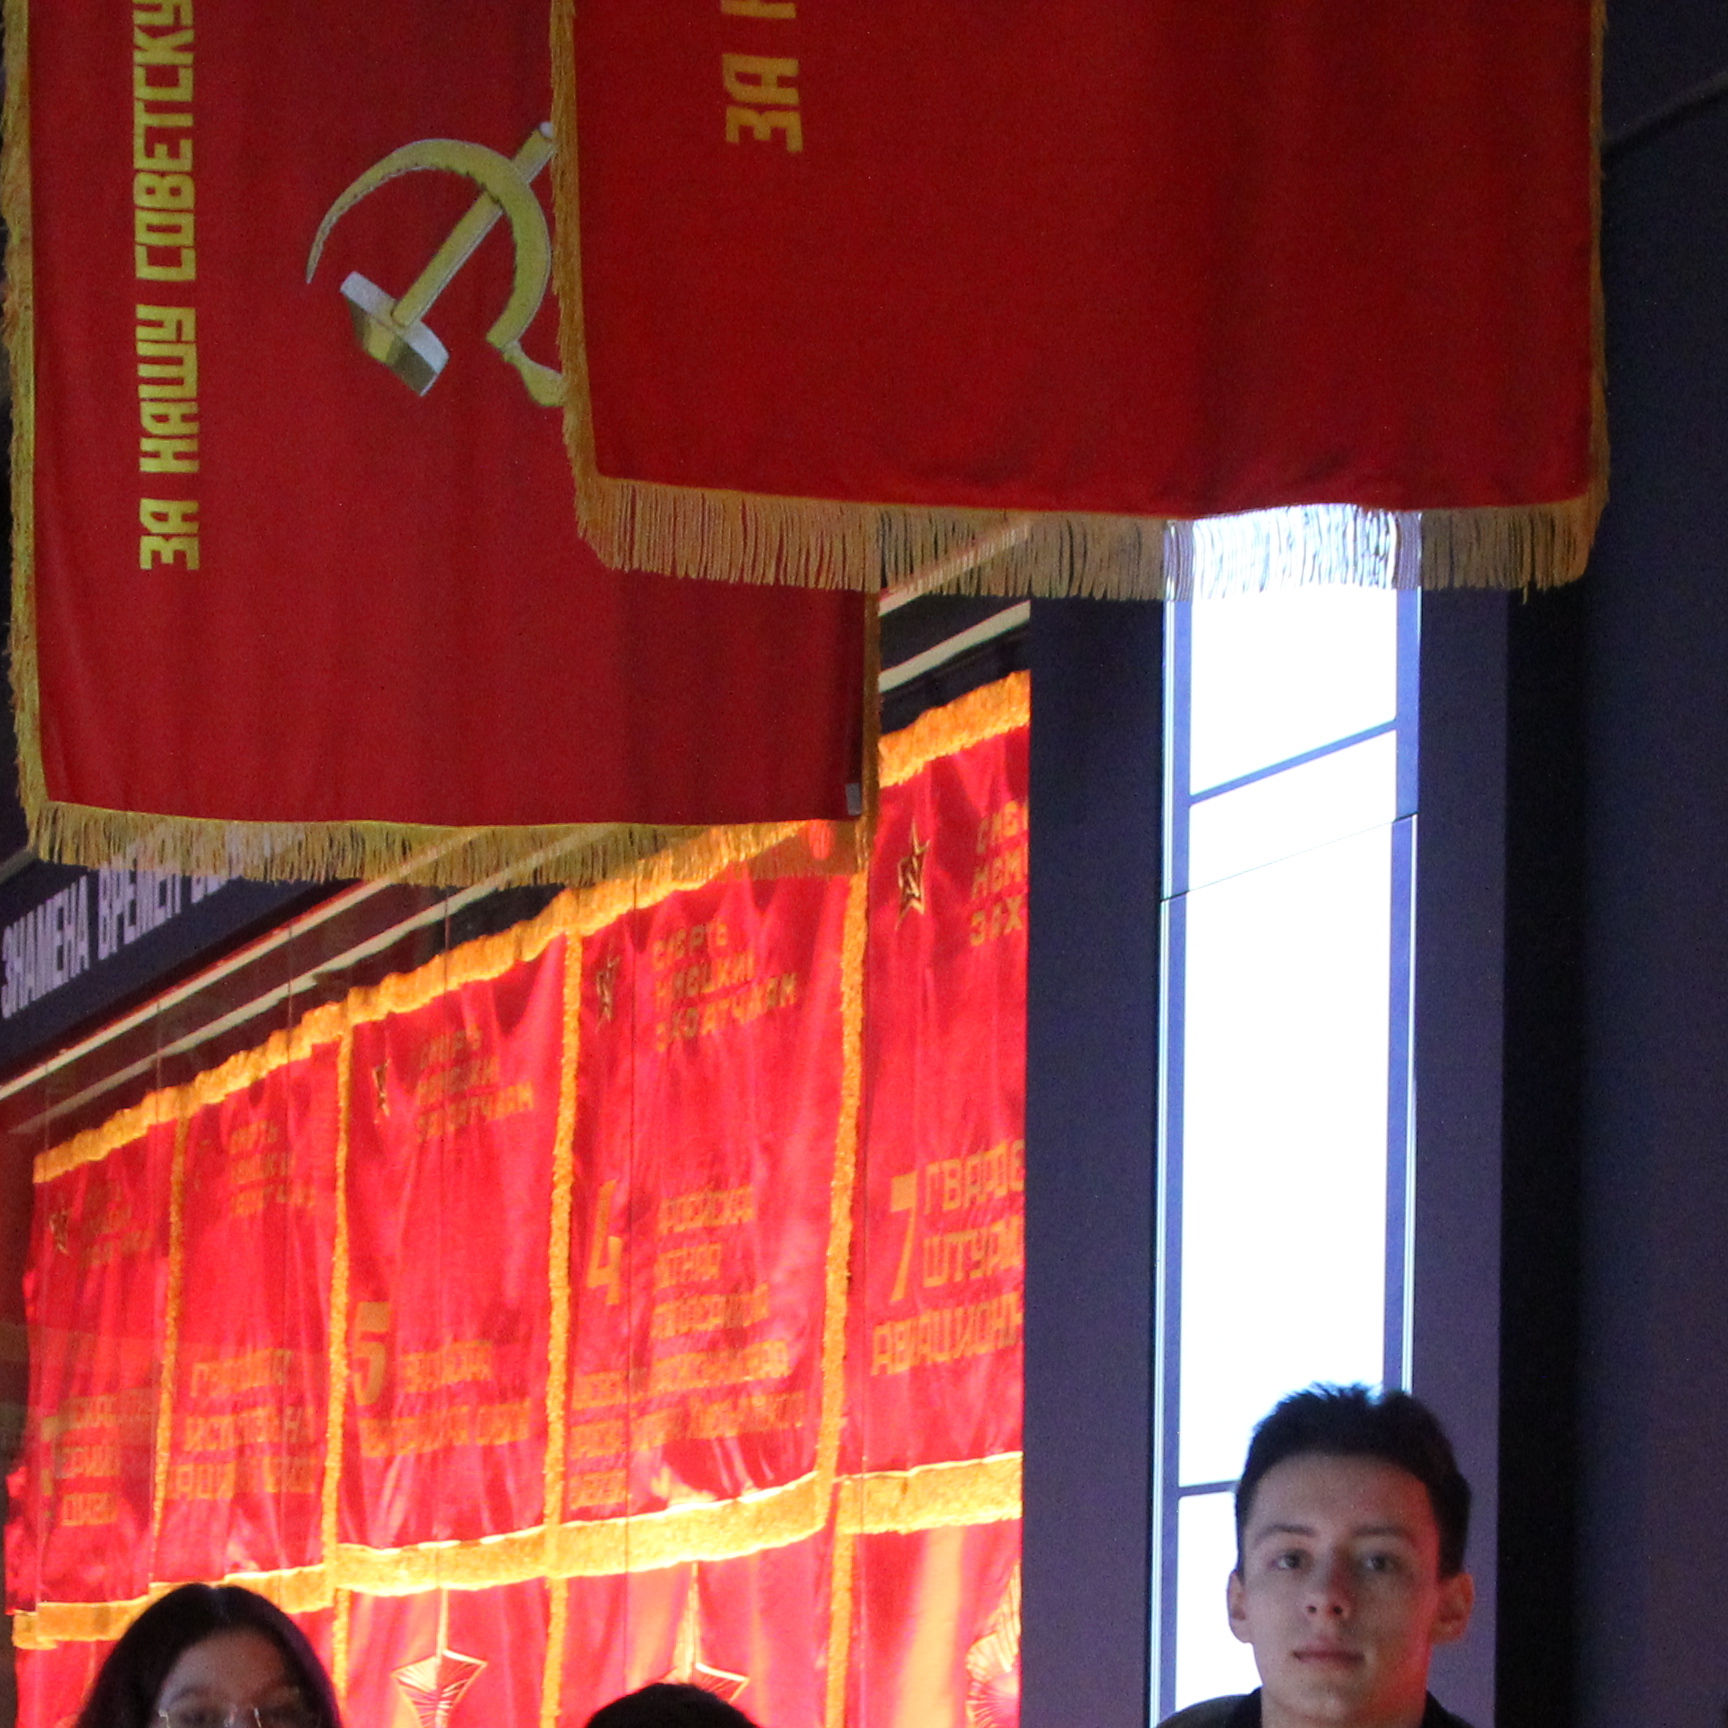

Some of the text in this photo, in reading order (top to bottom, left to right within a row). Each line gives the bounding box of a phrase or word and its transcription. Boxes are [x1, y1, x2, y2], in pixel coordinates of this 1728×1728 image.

[722, 53, 803, 152] ЗА
[135, 303, 200, 473] НАШУ
[139, 497, 200, 570] ЗА
